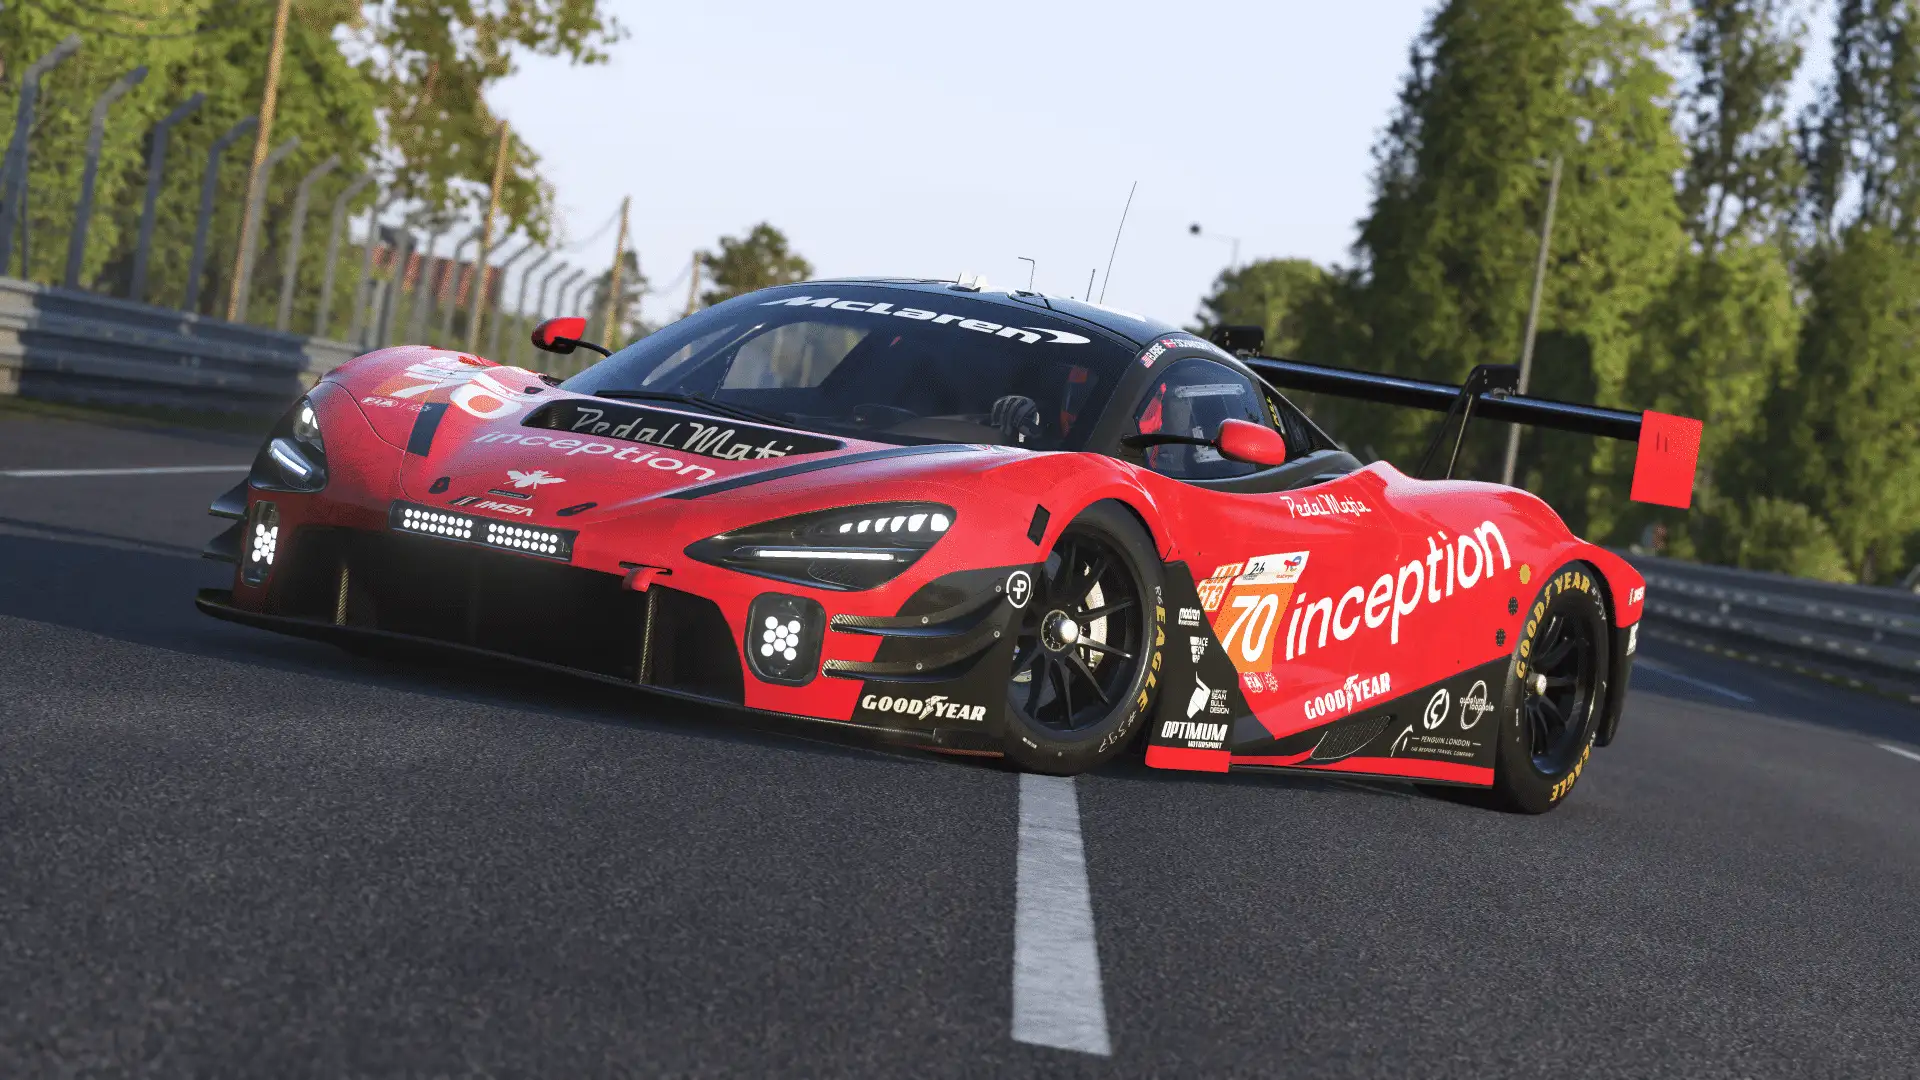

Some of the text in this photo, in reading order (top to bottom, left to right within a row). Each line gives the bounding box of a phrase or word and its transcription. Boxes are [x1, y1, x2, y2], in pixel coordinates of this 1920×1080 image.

[759, 296, 1042, 344] McLaren
[576, 406, 675, 448] Pedal
[473, 432, 715, 481] inception
[474, 501, 534, 517] IMSA
[1280, 494, 1372, 518] Pedal Mafia
[1197, 584, 1224, 610] GT3
[1285, 520, 1512, 661] inception
[1221, 593, 1279, 662] 70
[1136, 604, 1167, 714] EAGLE
[1210, 706, 1230, 714] DESIGN
[1161, 721, 1228, 741] OPTIMUM
[1187, 741, 1223, 749] MOTORSPORT
[1421, 735, 1471, 747] PENGUIN LONDON
[1549, 744, 1590, 801] EAGLE
